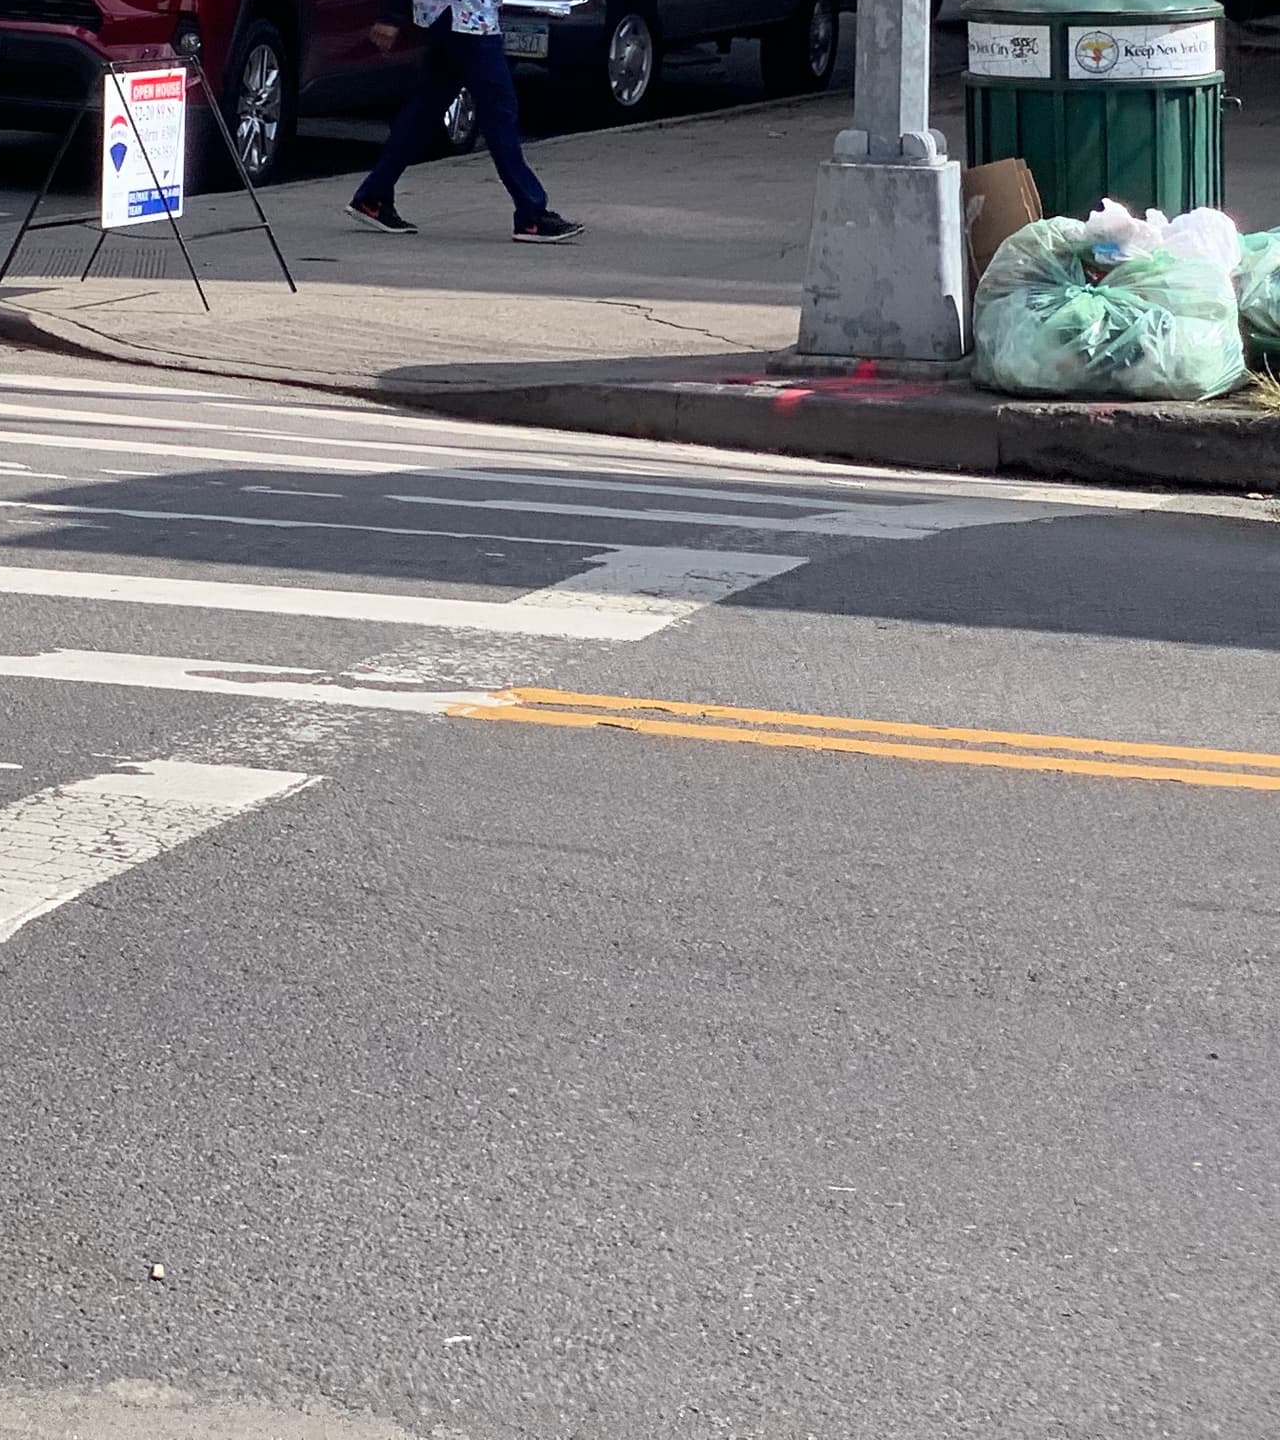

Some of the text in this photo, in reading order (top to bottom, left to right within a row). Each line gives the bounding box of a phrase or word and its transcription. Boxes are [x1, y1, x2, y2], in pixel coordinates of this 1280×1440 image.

[1124, 44, 1155, 59] Keep
[1156, 43, 1178, 56] New
[132, 80, 182, 101] OPEN HOUSE
